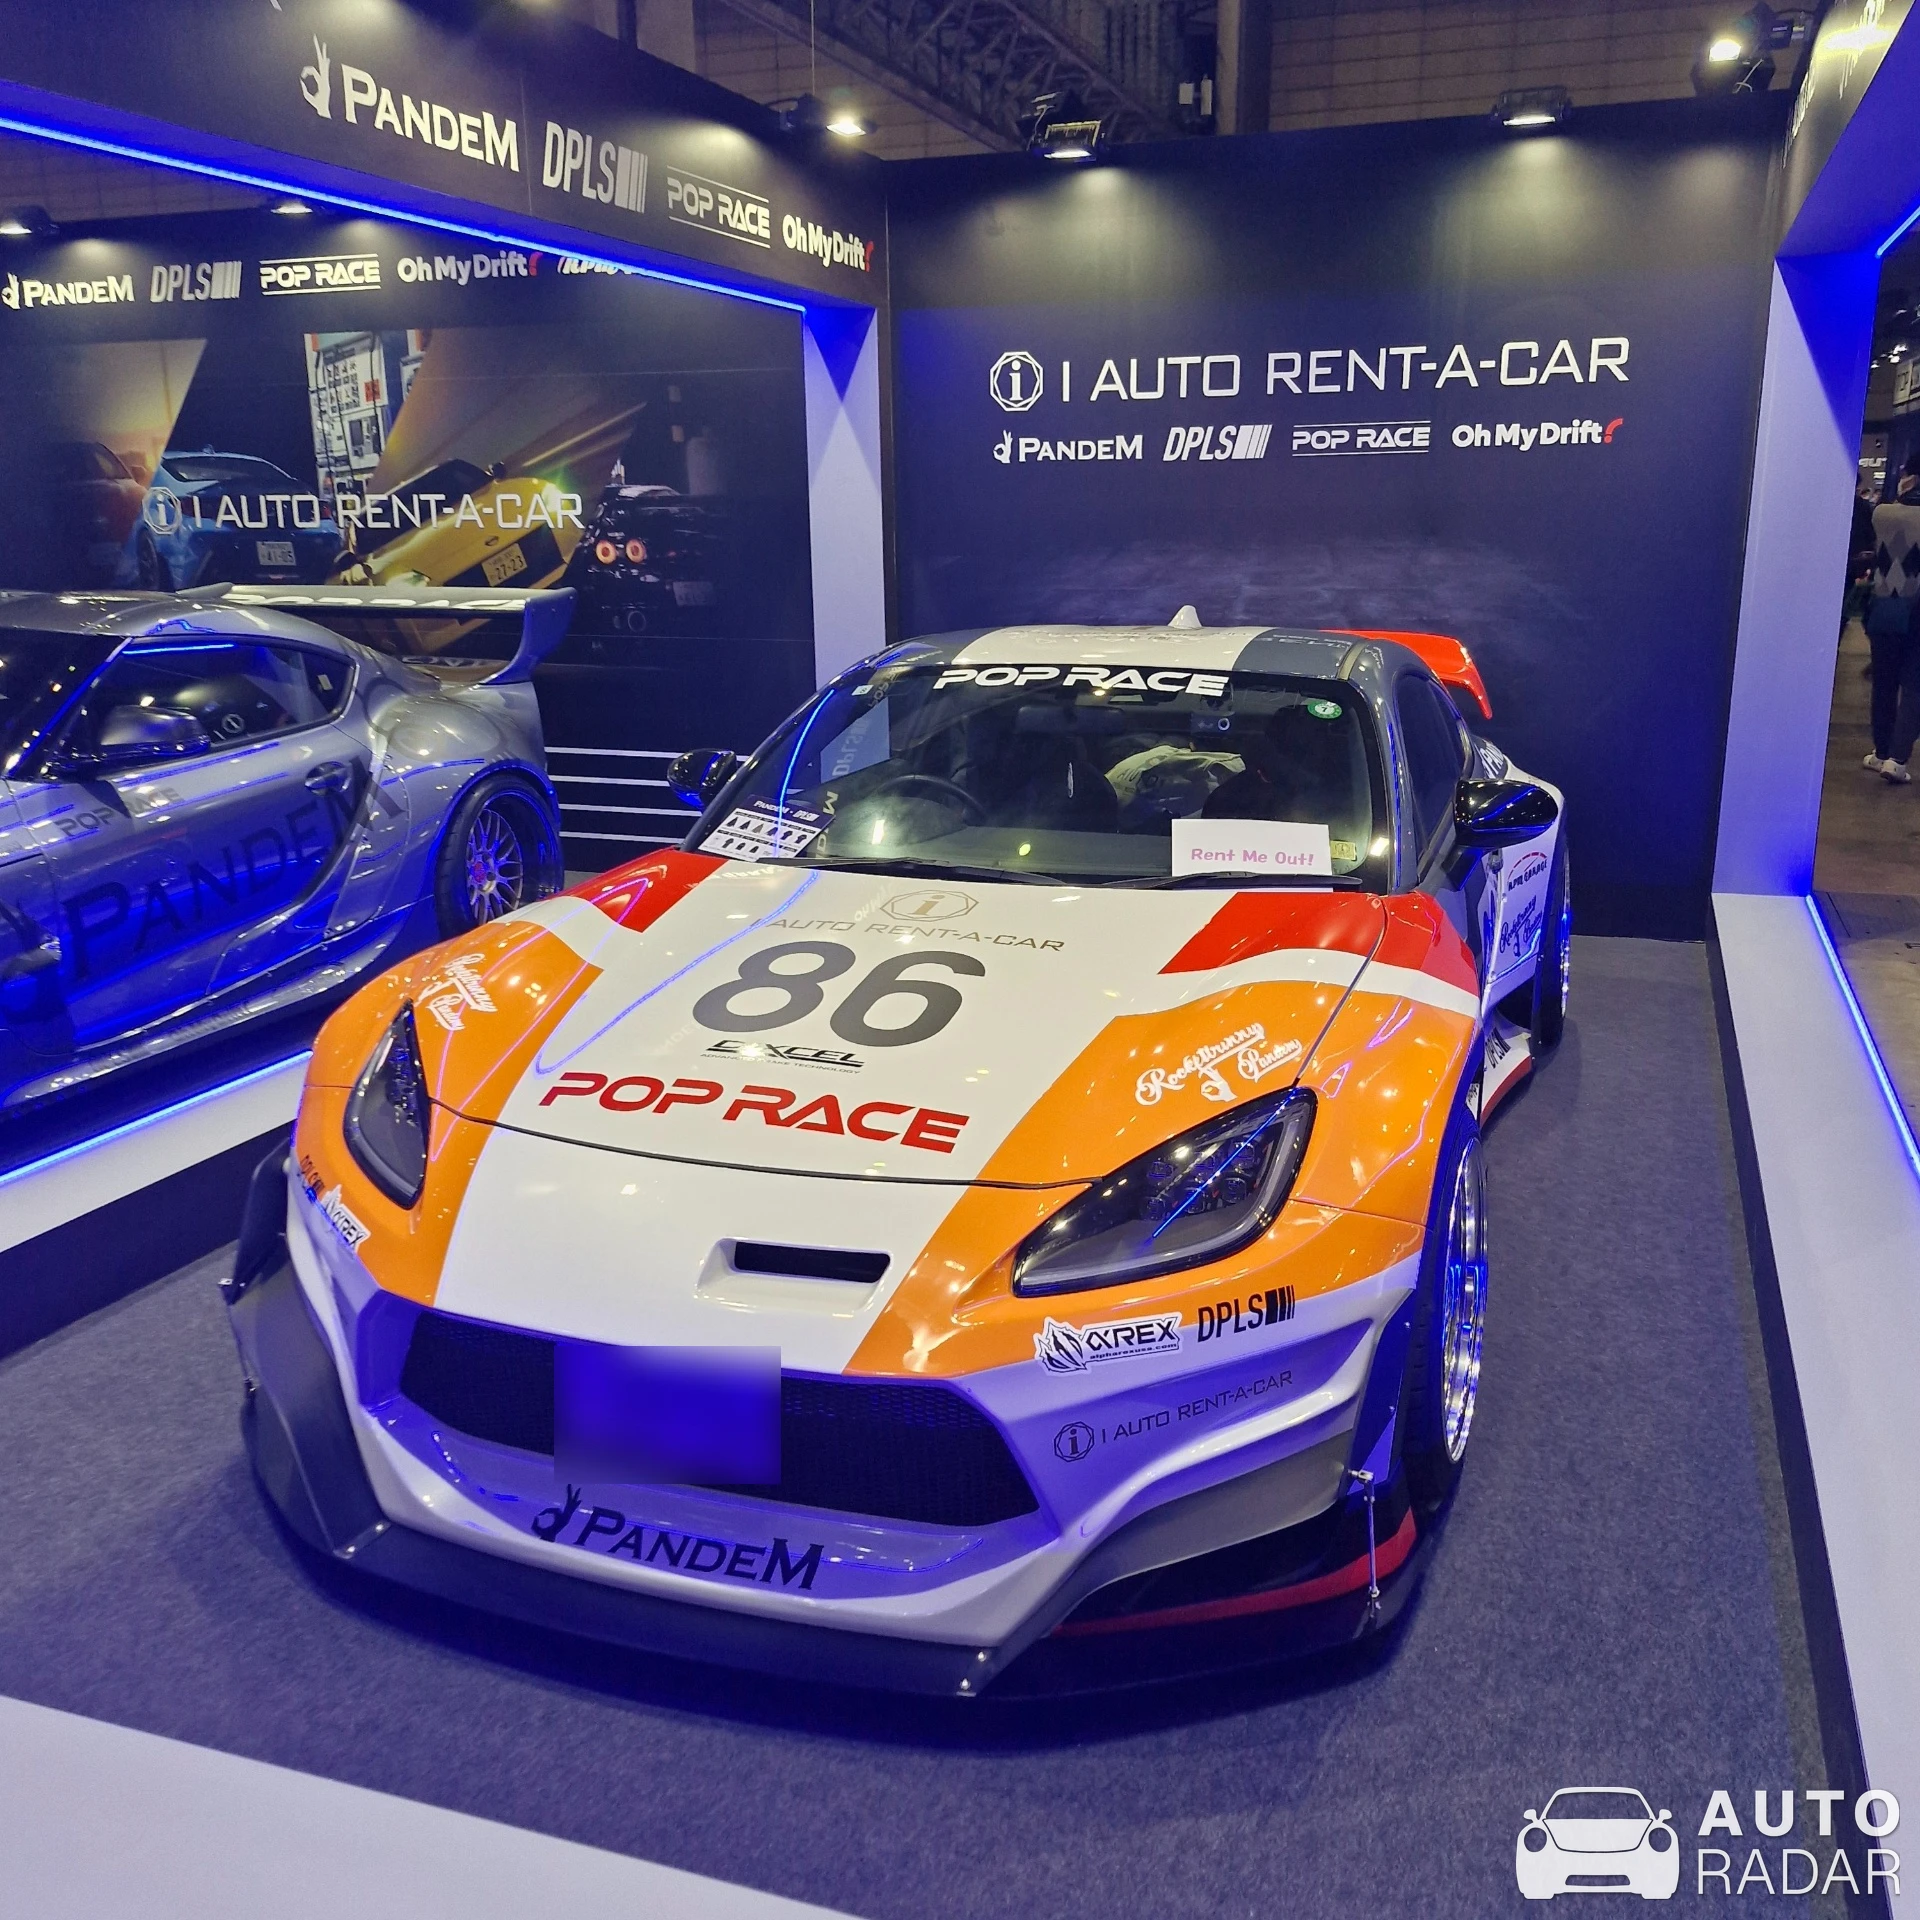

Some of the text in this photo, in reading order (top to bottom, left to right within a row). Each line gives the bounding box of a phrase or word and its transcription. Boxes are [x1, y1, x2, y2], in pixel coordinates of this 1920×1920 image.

[341, 63, 520, 173] PANDEM
[543, 121, 616, 204] DPLS
[667, 177, 771, 239] POP RACE
[23, 275, 135, 308] PANDEM
[150, 262, 212, 303] DPLS
[260, 260, 381, 289] POP RACE
[1089, 353, 1241, 402] AUTO
[1266, 336, 1630, 396] RENT-A-CAR
[1018, 434, 1143, 462] PANDEM
[1162, 425, 1238, 462] DPLS
[1292, 426, 1431, 450] POP RACE
[216, 494, 321, 529] AUTO
[337, 493, 585, 529] RENT-A-CAR
[933, 667, 1231, 698] POP RACE
[60, 755, 405, 978] PANDEM
[1191, 848, 1314, 866] Rent Me Out!
[766, 919, 857, 931] AUTO
[865, 923, 1065, 951] RENT-A-CAR
[692, 941, 986, 1047] 86
[539, 1072, 970, 1154] POP RACE
[1197, 1293, 1263, 1342] DPLS
[1113, 1410, 1170, 1441] AUTO
[1178, 1371, 1292, 1421] RENT-A-CAR
[573, 1506, 825, 1590] PANDEM
